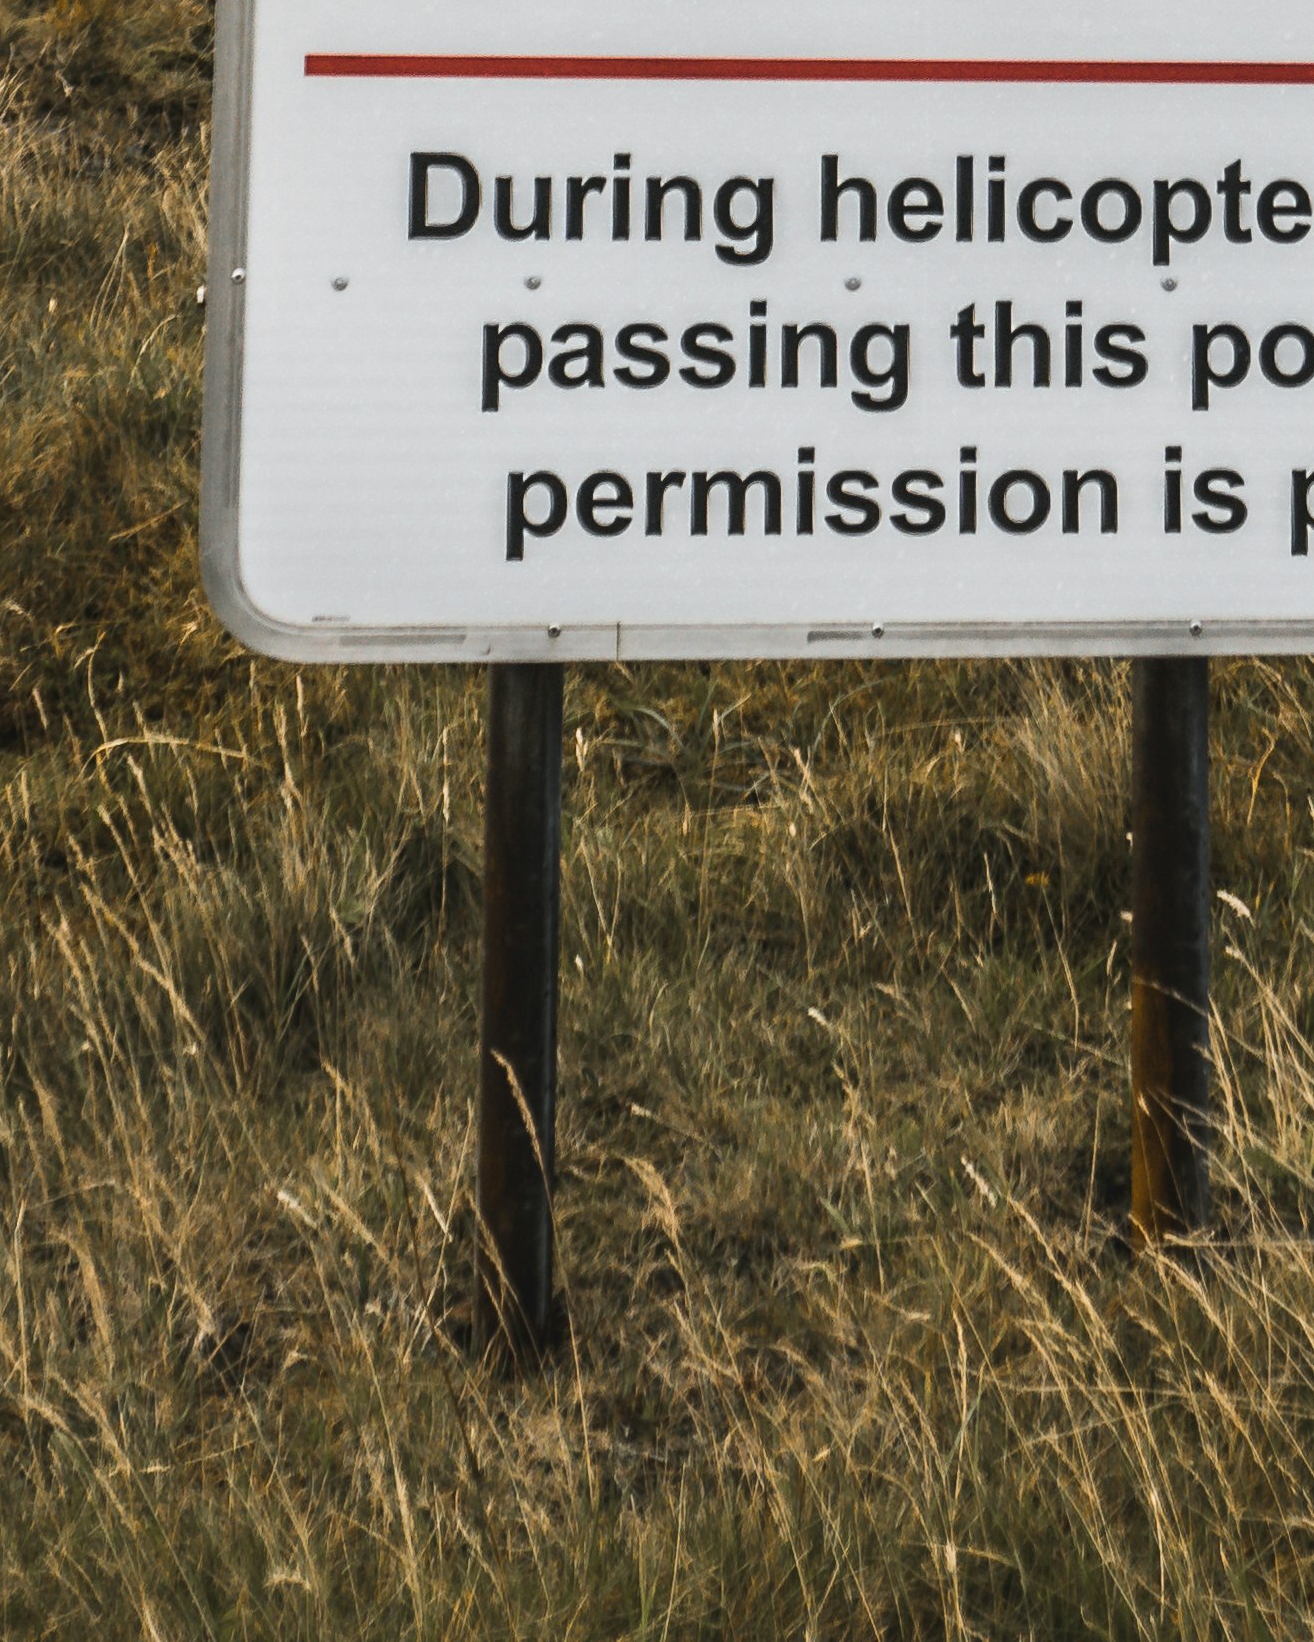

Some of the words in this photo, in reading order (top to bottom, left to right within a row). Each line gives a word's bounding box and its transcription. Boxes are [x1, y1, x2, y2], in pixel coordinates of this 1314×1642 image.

[406, 150, 776, 267] During
[480, 299, 911, 413] passing
[949, 299, 1150, 389] this
[505, 446, 1119, 562] permission
[1163, 444, 1249, 535] is
